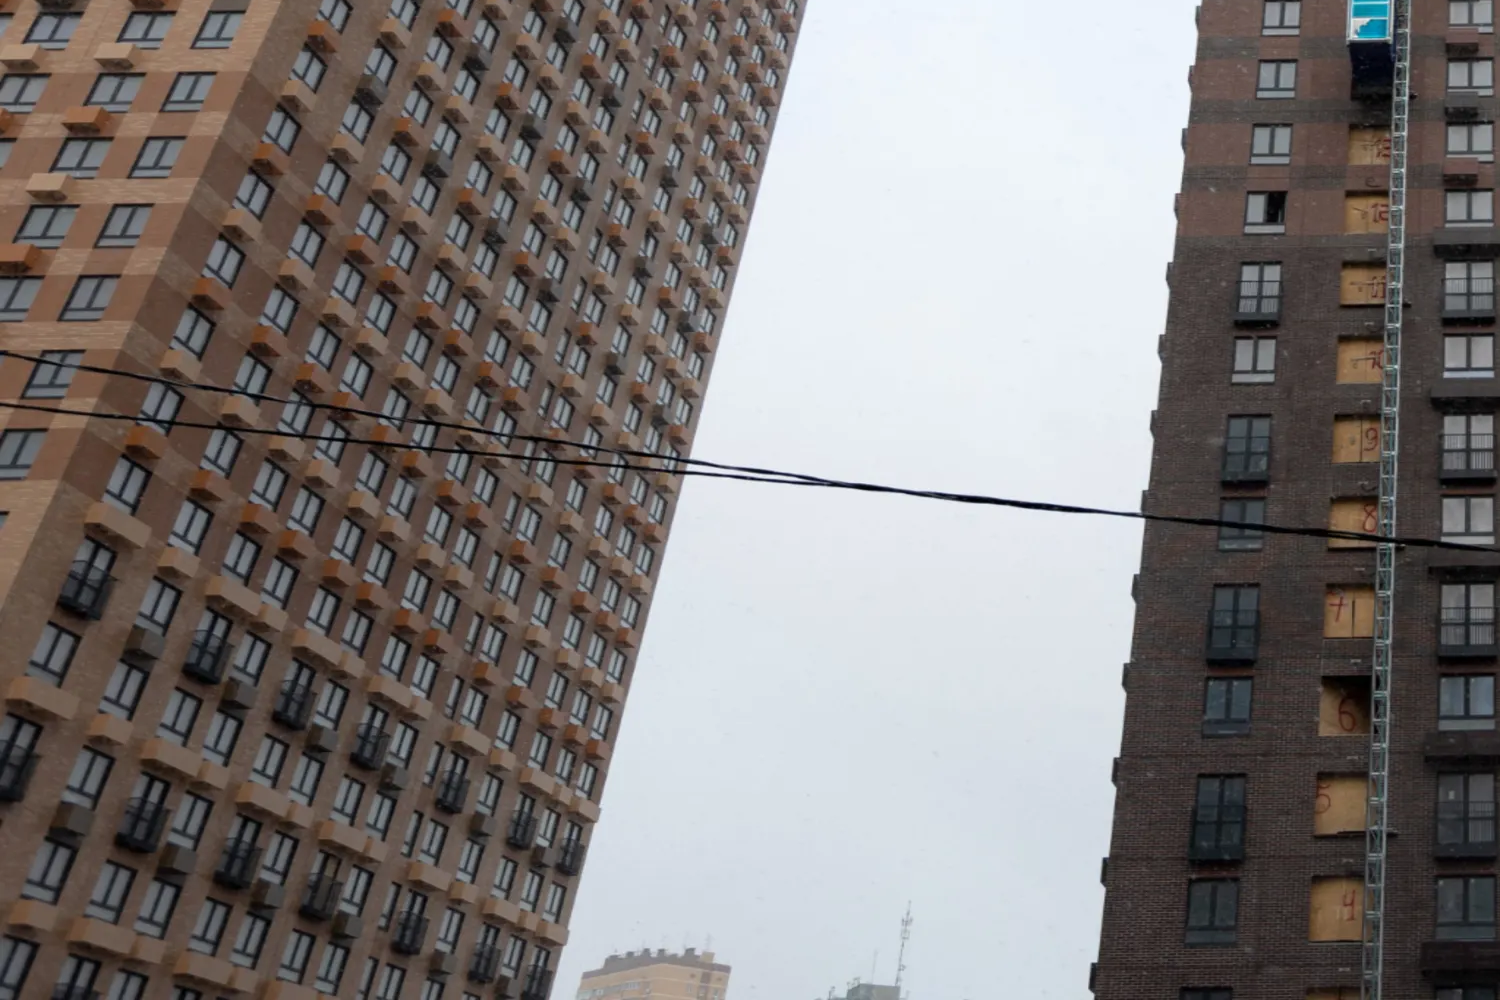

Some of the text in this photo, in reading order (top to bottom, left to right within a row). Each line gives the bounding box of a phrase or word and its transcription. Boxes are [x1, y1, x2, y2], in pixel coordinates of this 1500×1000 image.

[1363, 427, 1378, 452] 9
[1362, 503, 1378, 533] 8
[1337, 696, 1357, 732] 6
[1342, 888, 1356, 922] 4
